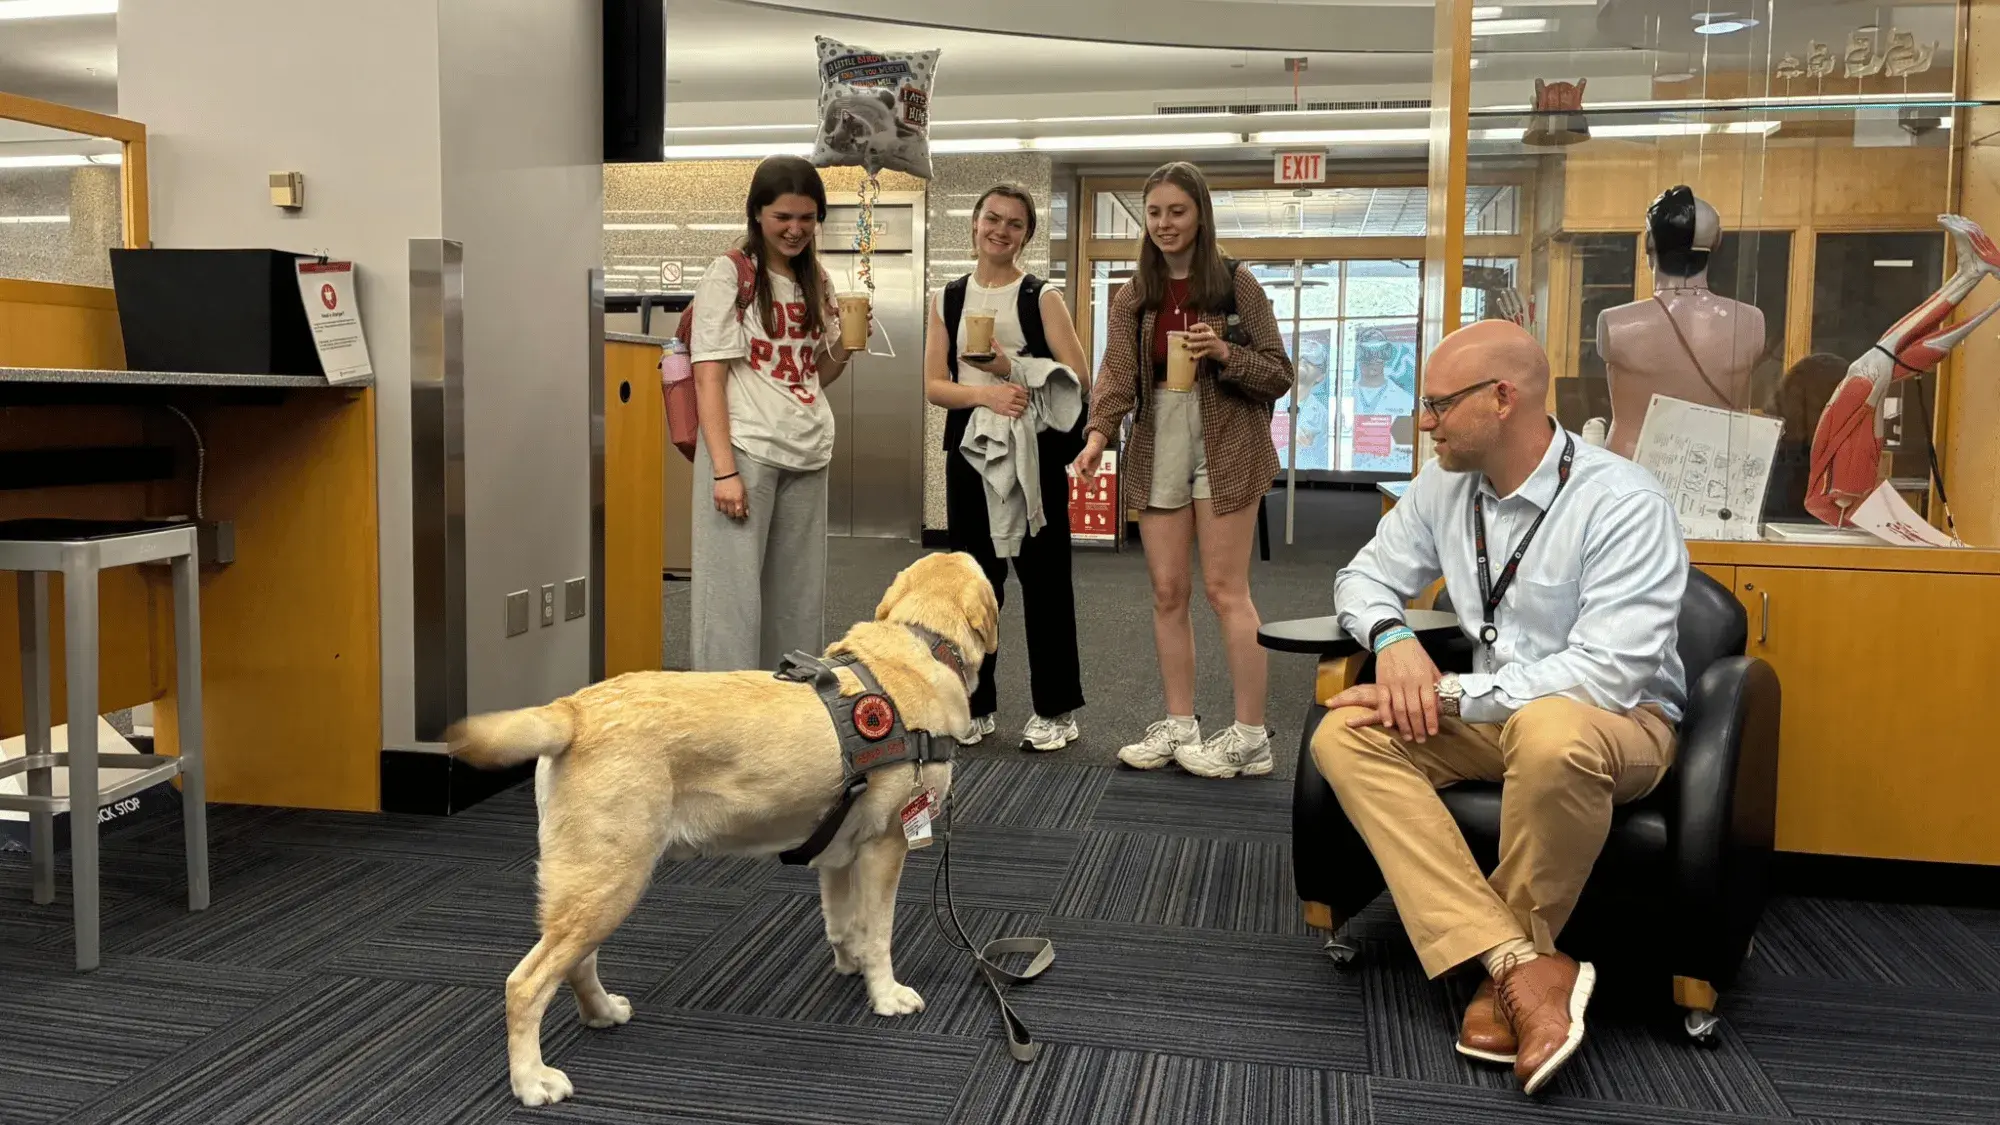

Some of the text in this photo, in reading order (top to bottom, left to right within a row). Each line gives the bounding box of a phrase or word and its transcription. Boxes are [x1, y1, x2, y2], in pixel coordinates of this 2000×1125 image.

[828, 63, 835, 75] A
[834, 57, 856, 69] LITTLE
[864, 68, 878, 76] YOU
[909, 92, 926, 104] ATE
[1282, 155, 1321, 180] EXIT
[97, 797, 141, 824] ICK STOP
